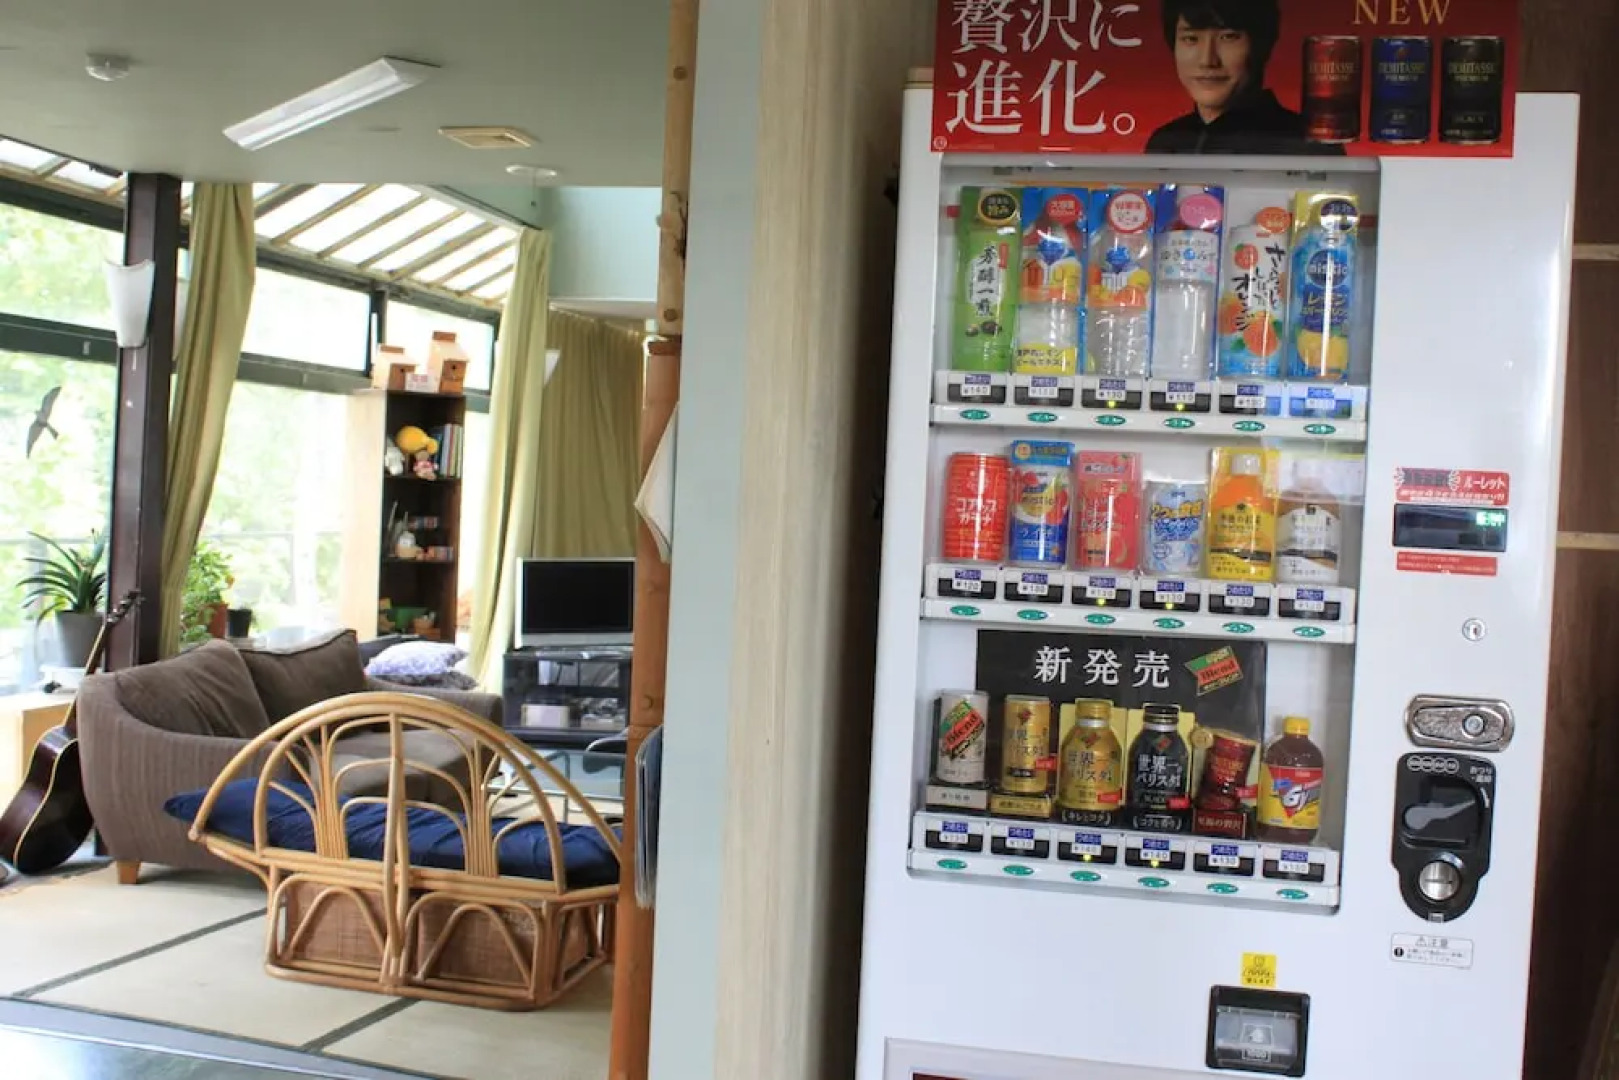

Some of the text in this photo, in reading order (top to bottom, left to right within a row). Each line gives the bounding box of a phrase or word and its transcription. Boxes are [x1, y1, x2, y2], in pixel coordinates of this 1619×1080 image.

[1351, 0, 1451, 25] NEW
[945, 59, 1142, 137] 進化。
[1464, 475, 1505, 490] ルーレット
[1034, 644, 1171, 689] 新発売
